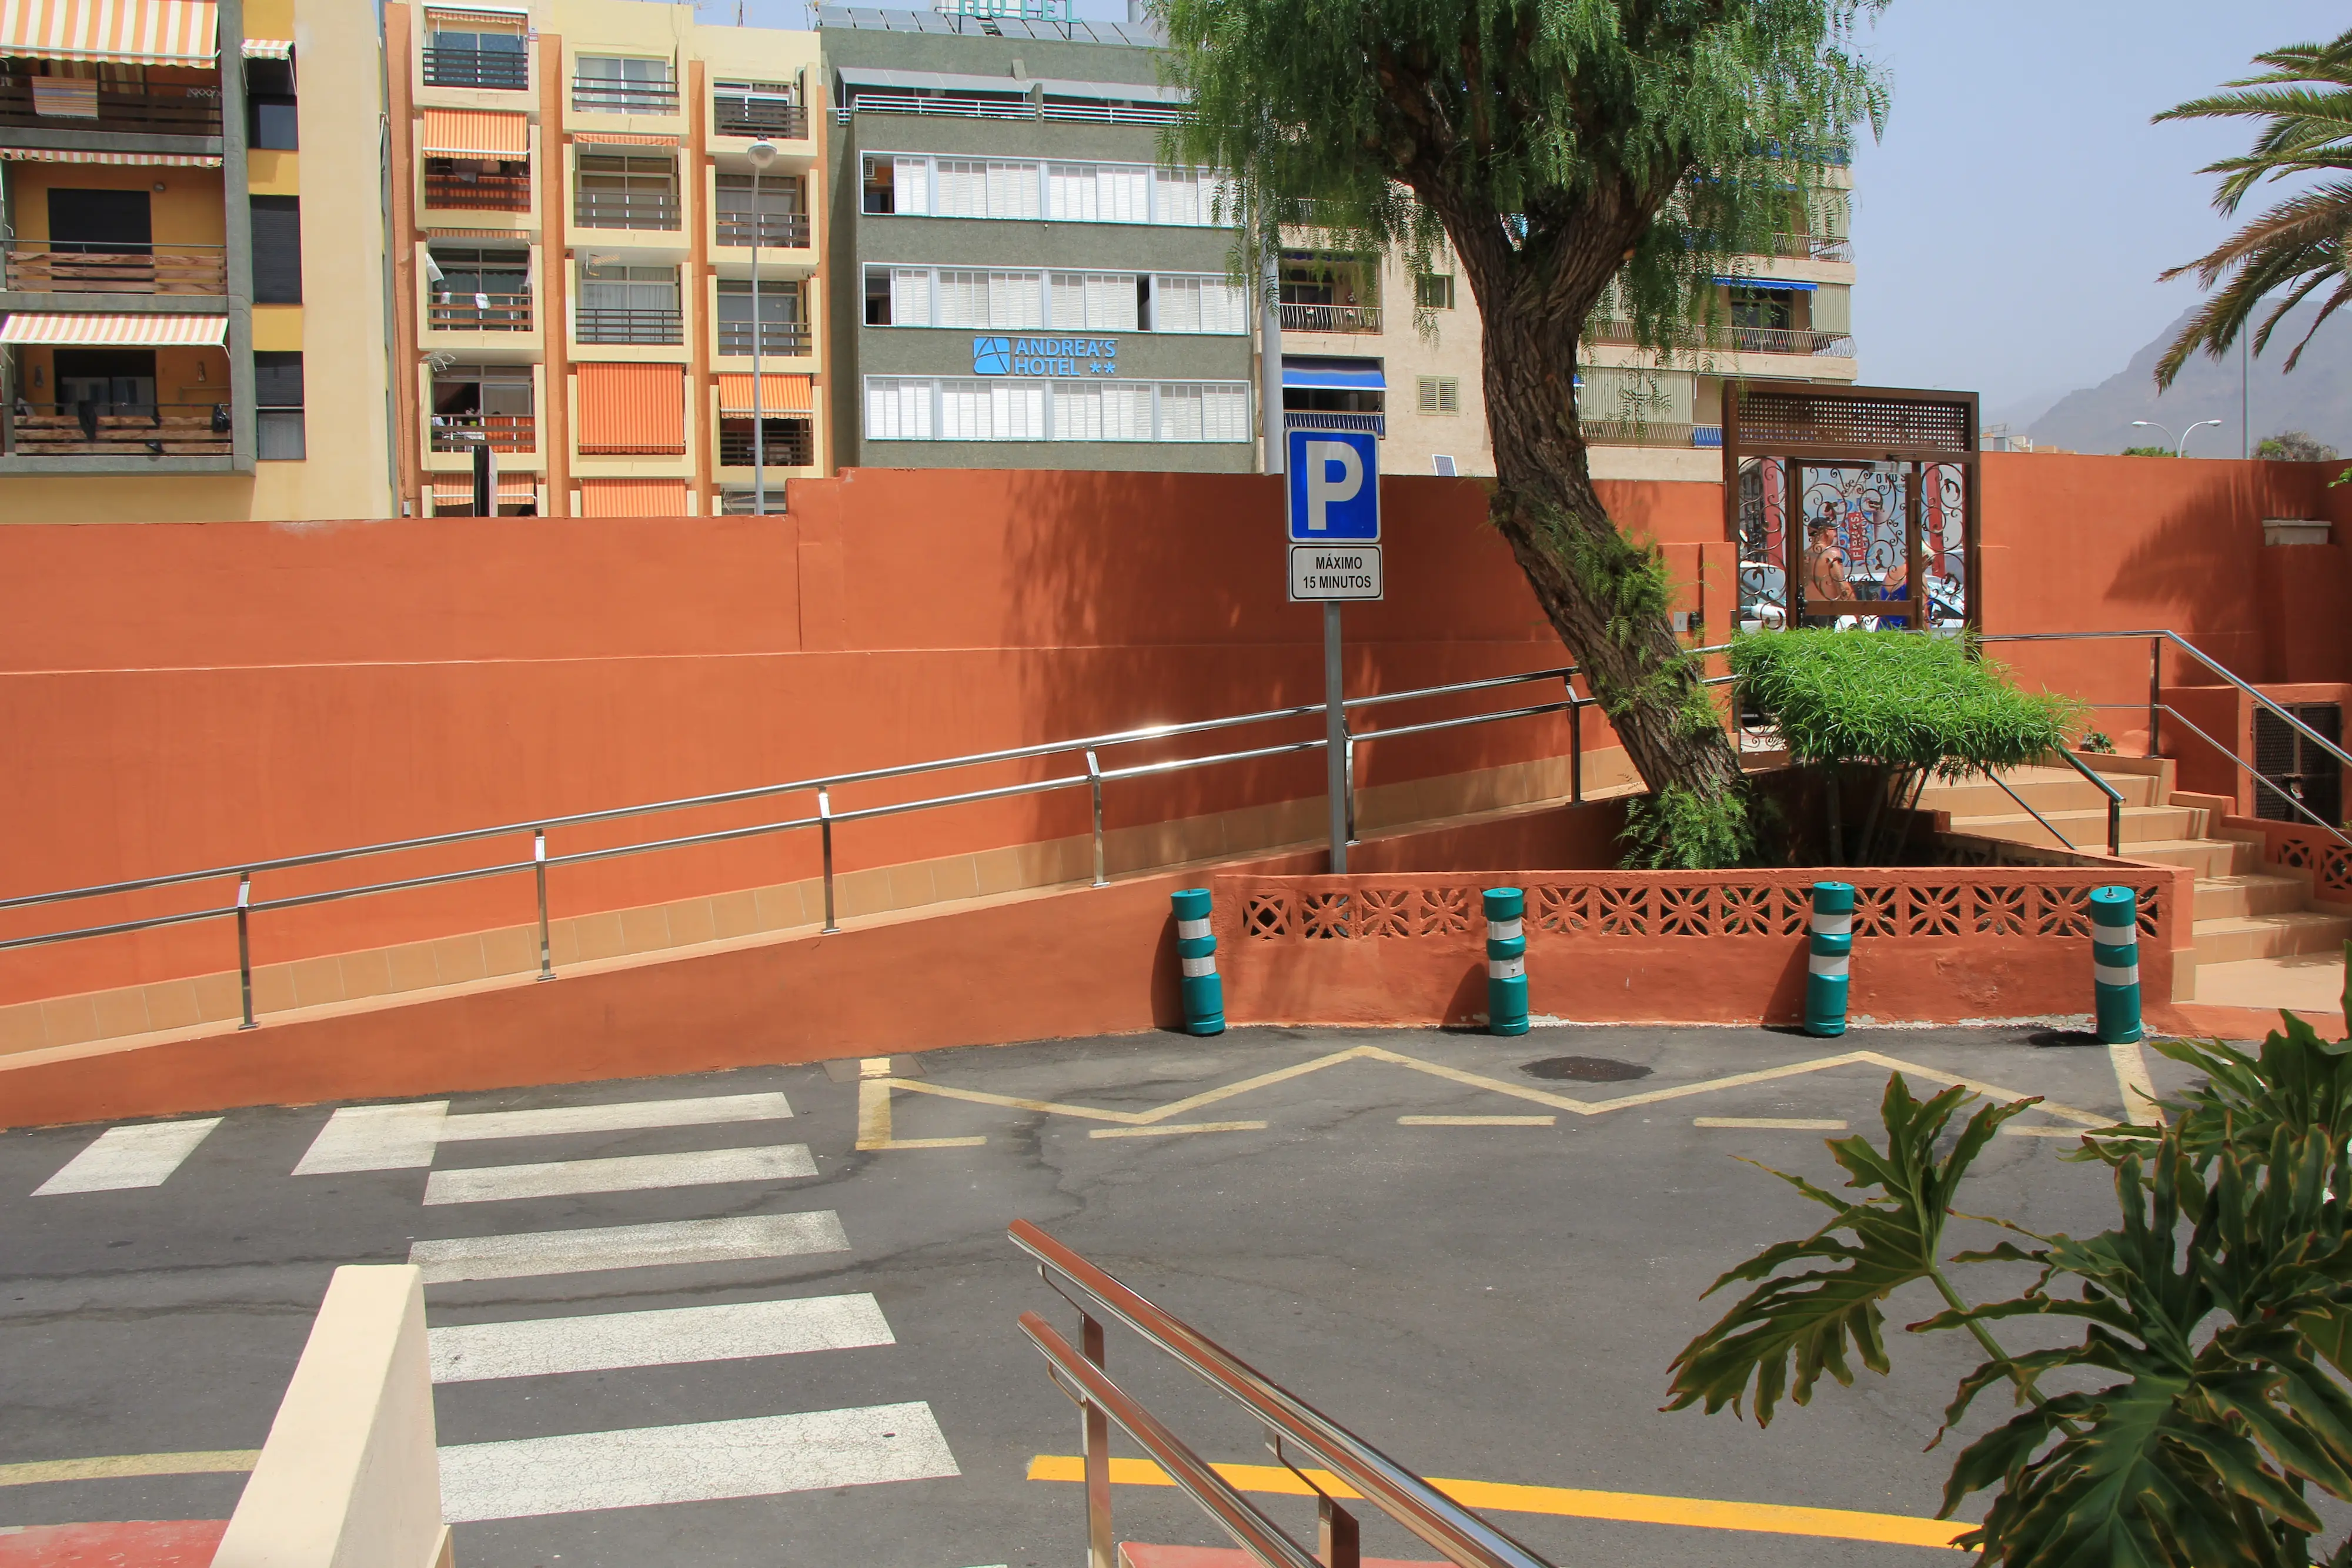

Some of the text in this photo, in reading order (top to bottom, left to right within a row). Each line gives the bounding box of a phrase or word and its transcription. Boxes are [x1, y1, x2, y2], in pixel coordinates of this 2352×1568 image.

[958, 0, 1082, 23] HOTEL
[1015, 338, 1116, 357] ANDREA'S
[1014, 357, 1081, 376] HOTEL
[1305, 440, 1364, 530] P
[1316, 553, 1362, 570] MÁXIMO
[1303, 576, 1371, 589] 15 MINUTOS
